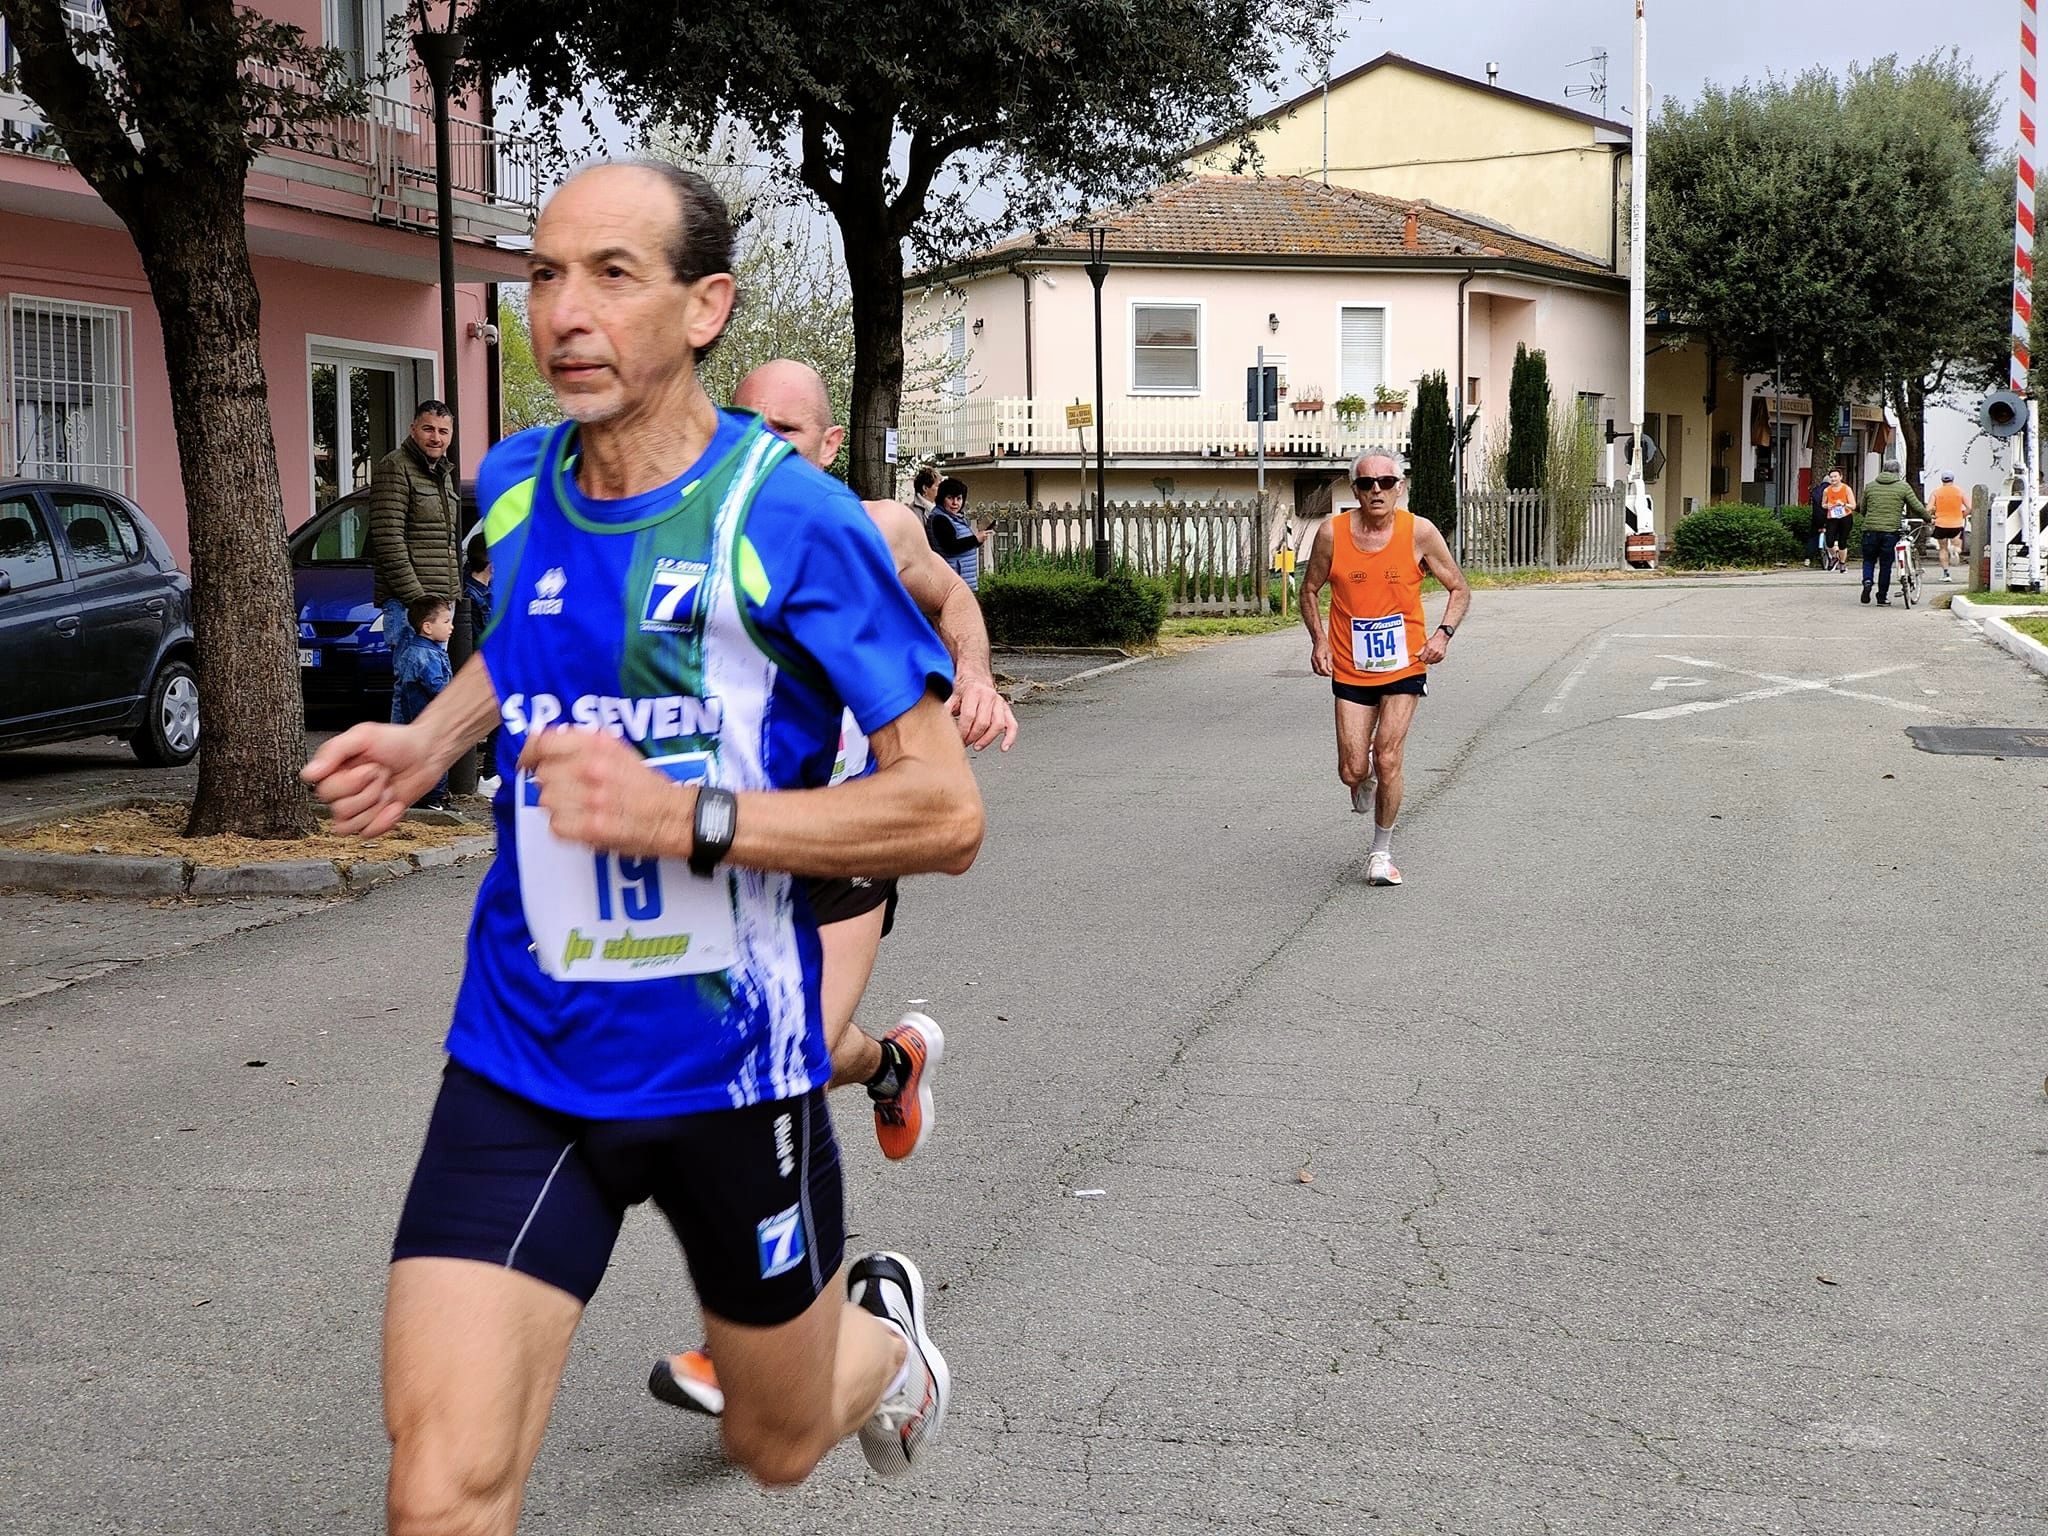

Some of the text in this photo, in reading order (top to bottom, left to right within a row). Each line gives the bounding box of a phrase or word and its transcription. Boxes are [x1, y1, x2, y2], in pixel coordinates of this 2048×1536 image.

[652, 572, 702, 621] 7
[1364, 630, 1396, 658] 154
[571, 694, 723, 741] SEVEN
[595, 848, 663, 921] 19
[761, 1213, 799, 1267] 7
